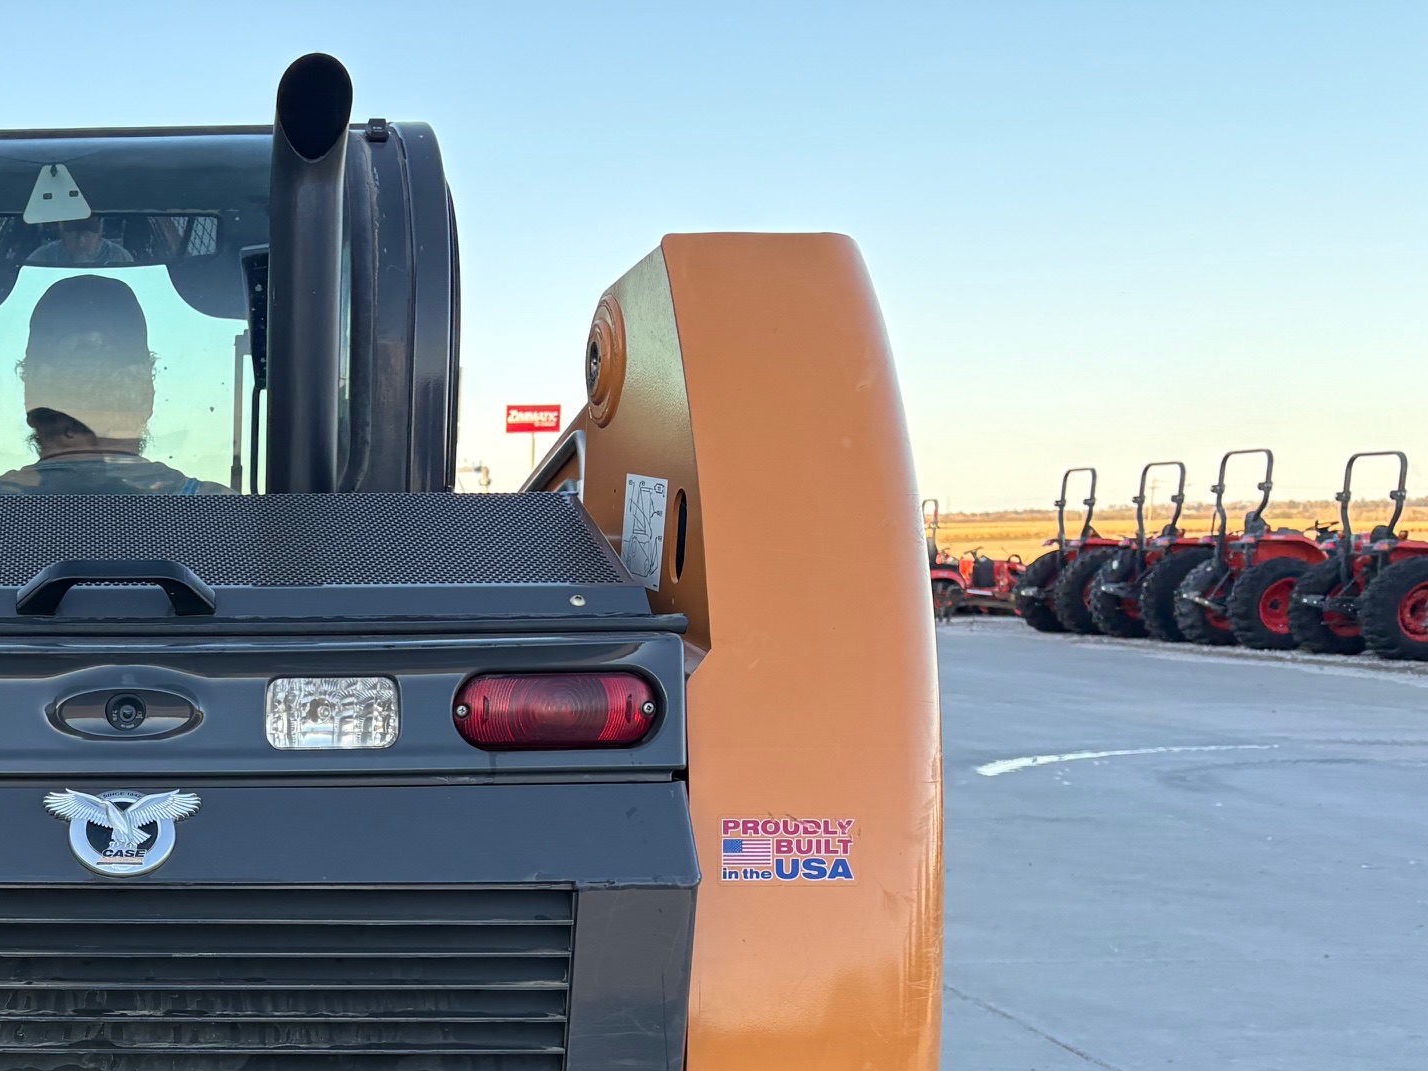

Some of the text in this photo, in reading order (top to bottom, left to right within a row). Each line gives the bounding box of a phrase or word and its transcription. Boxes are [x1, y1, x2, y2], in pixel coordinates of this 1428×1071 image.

[722, 819, 854, 836] PROUDLY
[102, 849, 147, 858] CASE
[774, 838, 853, 855] BUILT
[722, 857, 855, 881] in the USA
